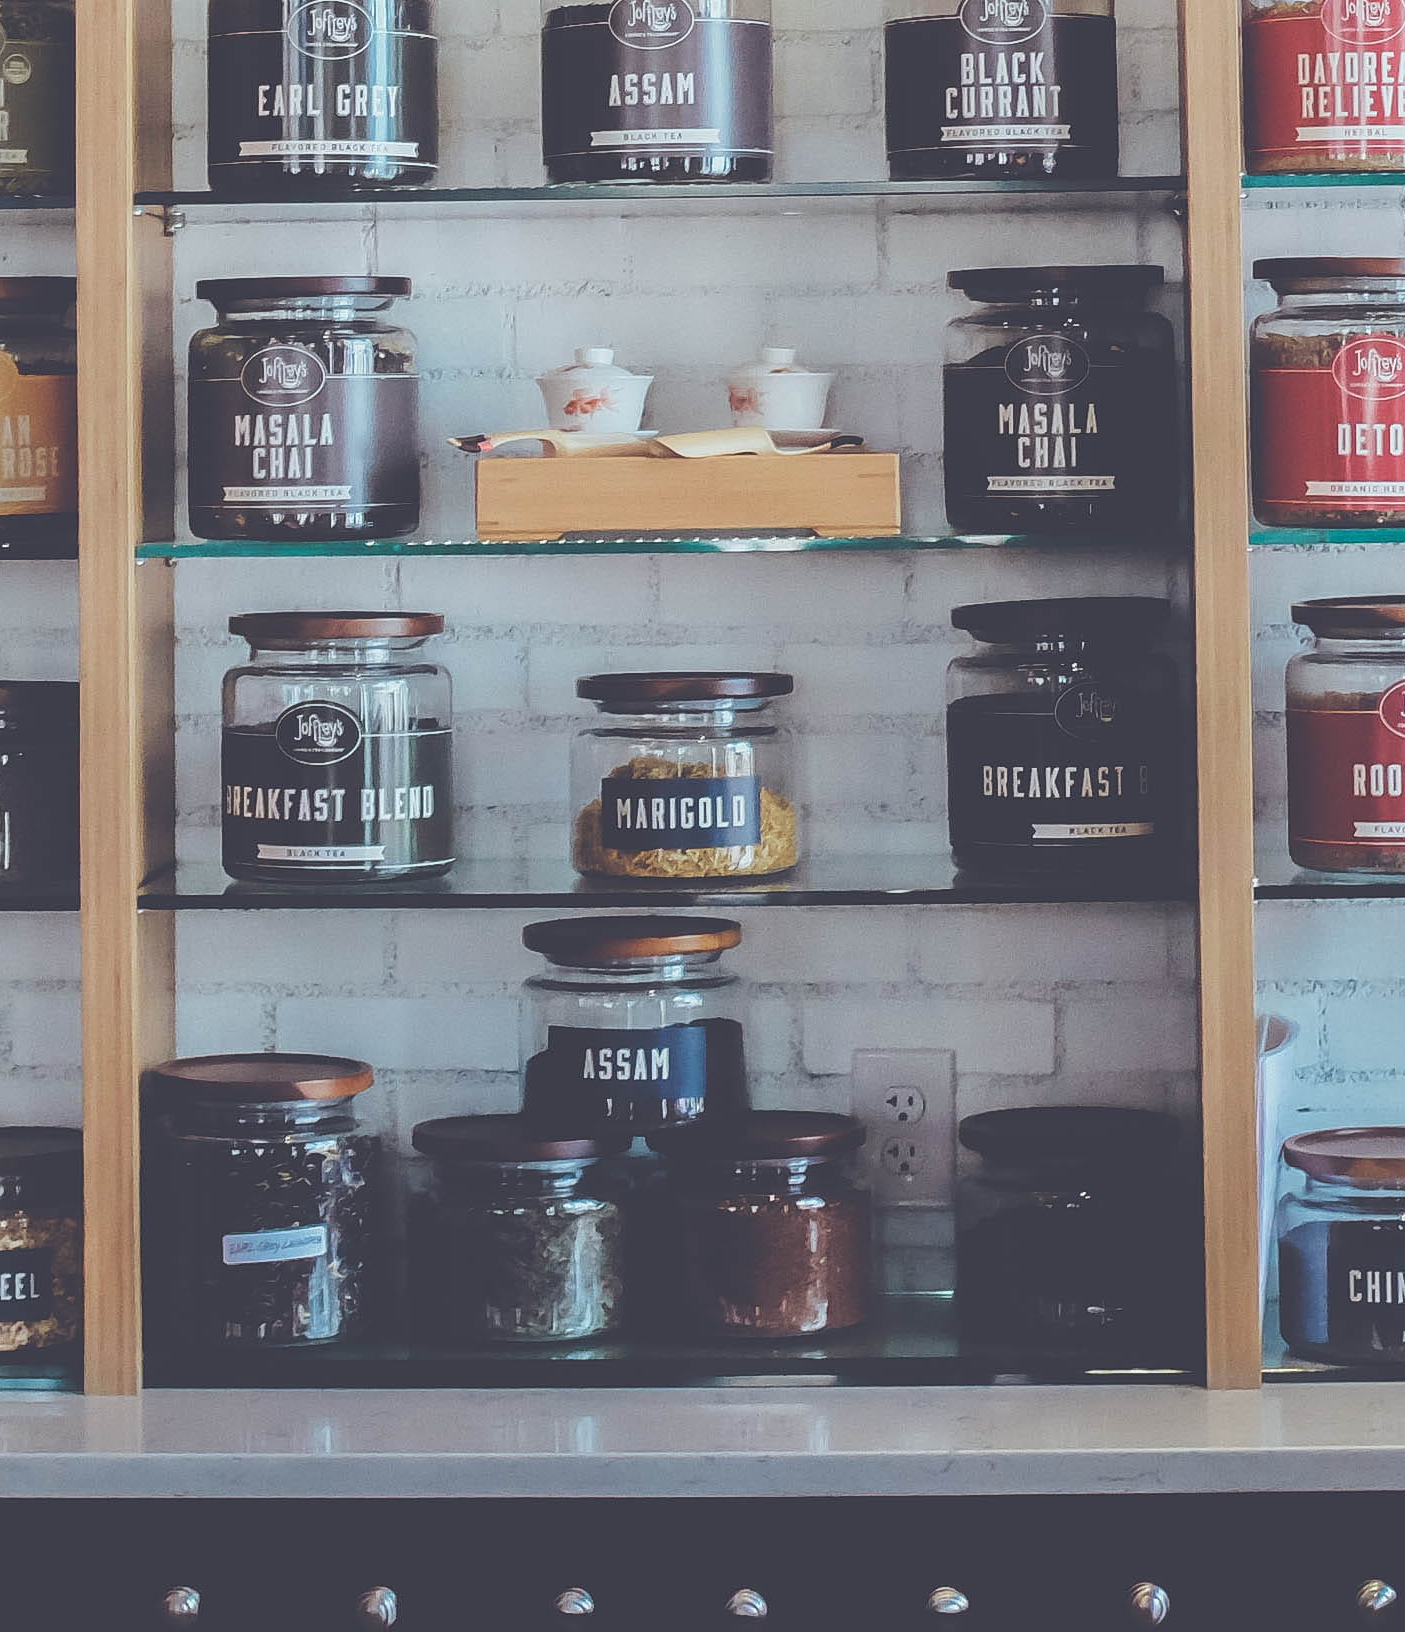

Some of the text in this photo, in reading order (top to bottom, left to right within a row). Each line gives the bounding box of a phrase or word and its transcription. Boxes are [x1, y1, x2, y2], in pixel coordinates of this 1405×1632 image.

[960, 52, 1044, 85] BLACK
[258, 84, 400, 117] EARL GREY
[608, 72, 695, 107] ASSAM
[945, 85, 1061, 119] CURRANT
[259, 356, 307, 389] Joffrey's
[1024, 345, 1072, 377] Joffrey's
[1352, 348, 1403, 382] Joffrey's
[235, 413, 334, 446] MASALA
[998, 403, 1098, 435] MASALA
[3, 446, 59, 479] ROSE
[252, 447, 314, 480] CHAI
[1018, 436, 1077, 468] CHAI
[294, 714, 344, 747] Joffrey's
[983, 765, 1124, 798] BREAKFAST
[226, 785, 434, 822] BREAKFAST BLEND
[616, 795, 745, 830] MARIGOLD
[582, 1046, 671, 1083] ASSAM
